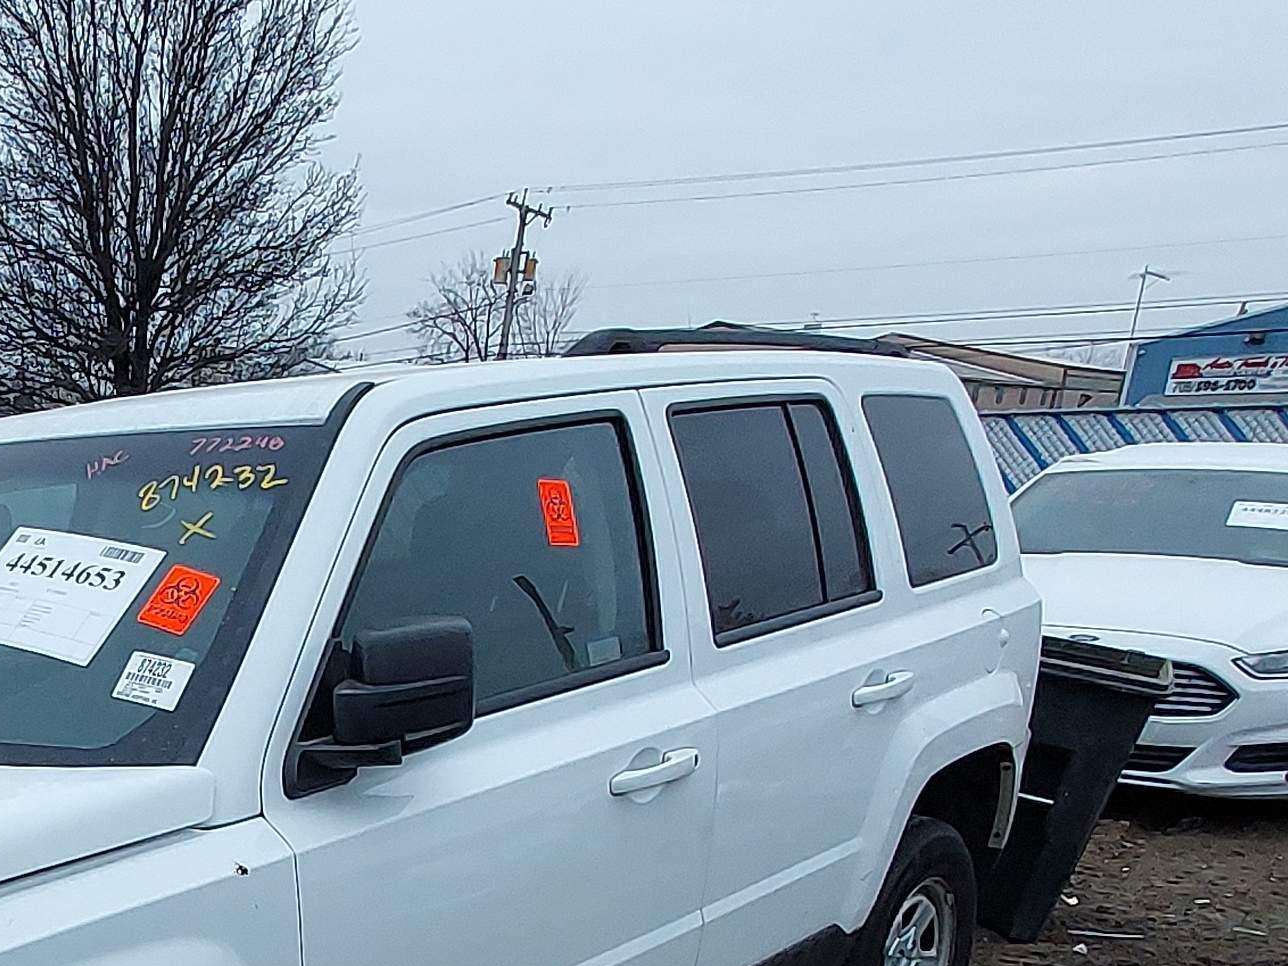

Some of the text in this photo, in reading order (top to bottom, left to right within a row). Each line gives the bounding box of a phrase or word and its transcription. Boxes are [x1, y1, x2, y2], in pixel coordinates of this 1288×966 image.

[137, 464, 289, 511] 874232
[5, 552, 126, 591] 44514653
[137, 658, 172, 679] 874232
